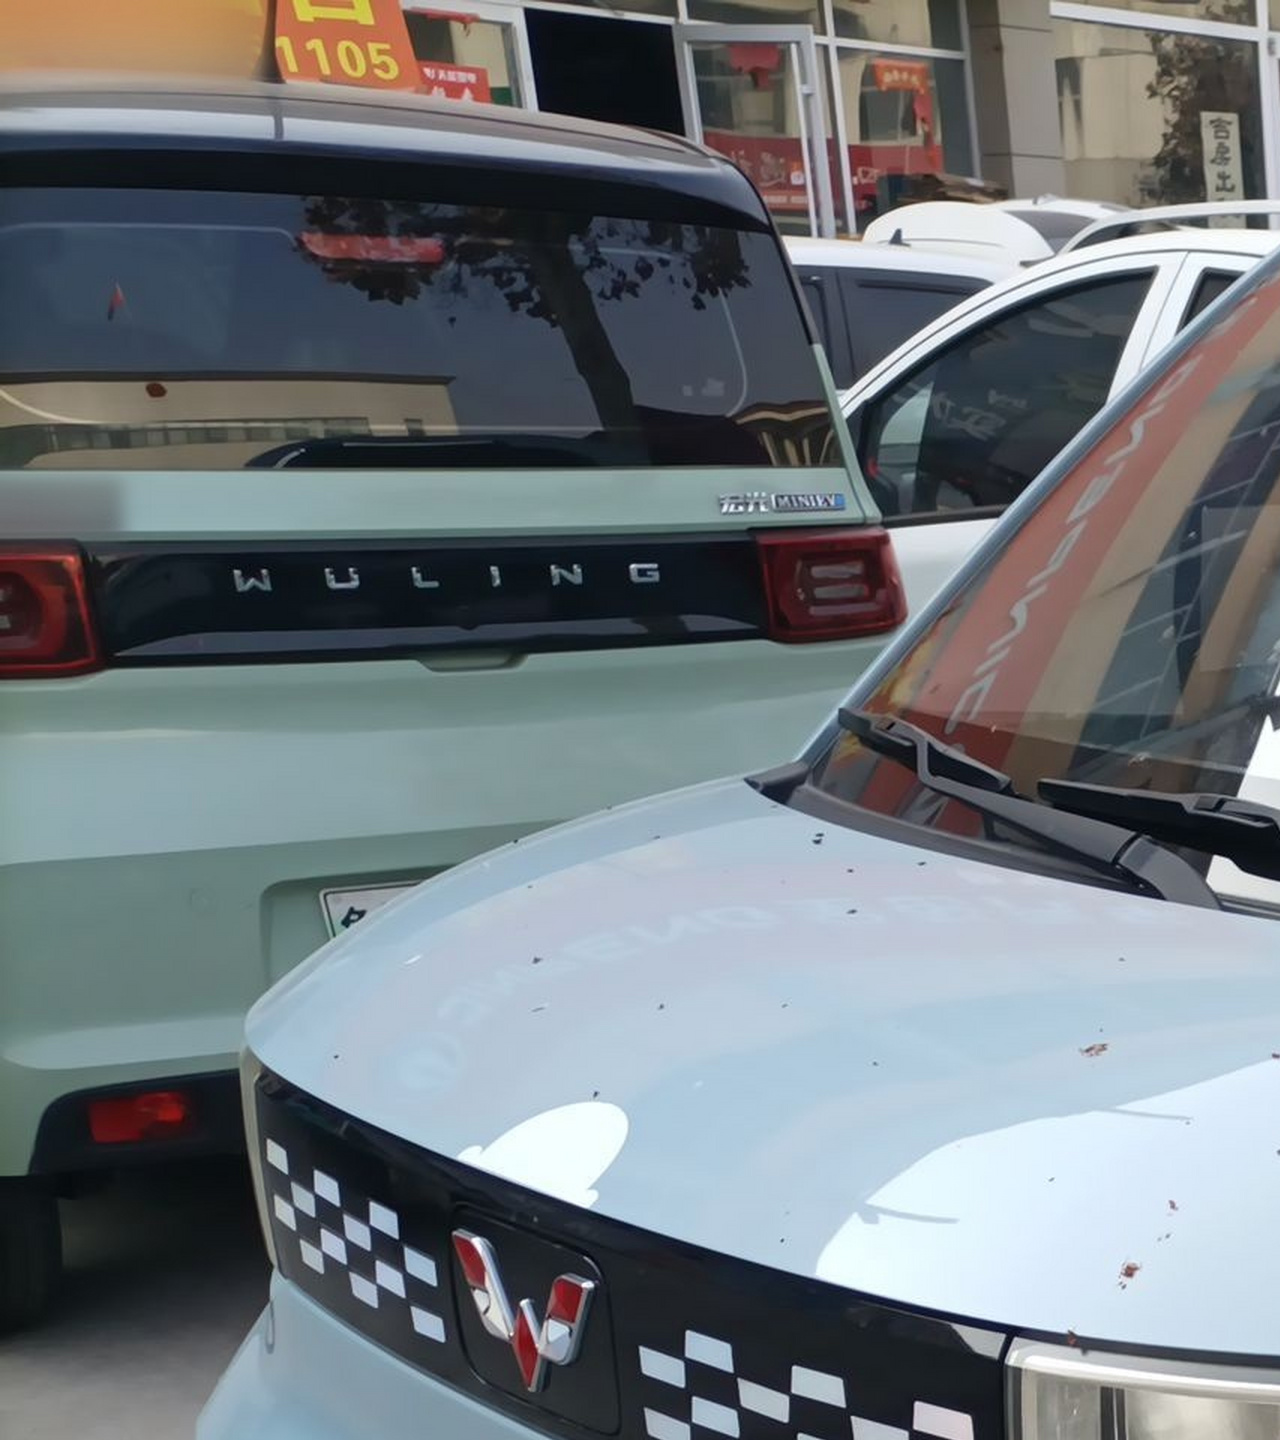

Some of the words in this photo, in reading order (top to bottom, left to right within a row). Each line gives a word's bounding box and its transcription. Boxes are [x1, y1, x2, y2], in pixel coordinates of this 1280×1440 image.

[275, 36, 399, 80] 1105
[1208, 117, 1240, 219] 吉房出
[233, 563, 660, 593] WULING
